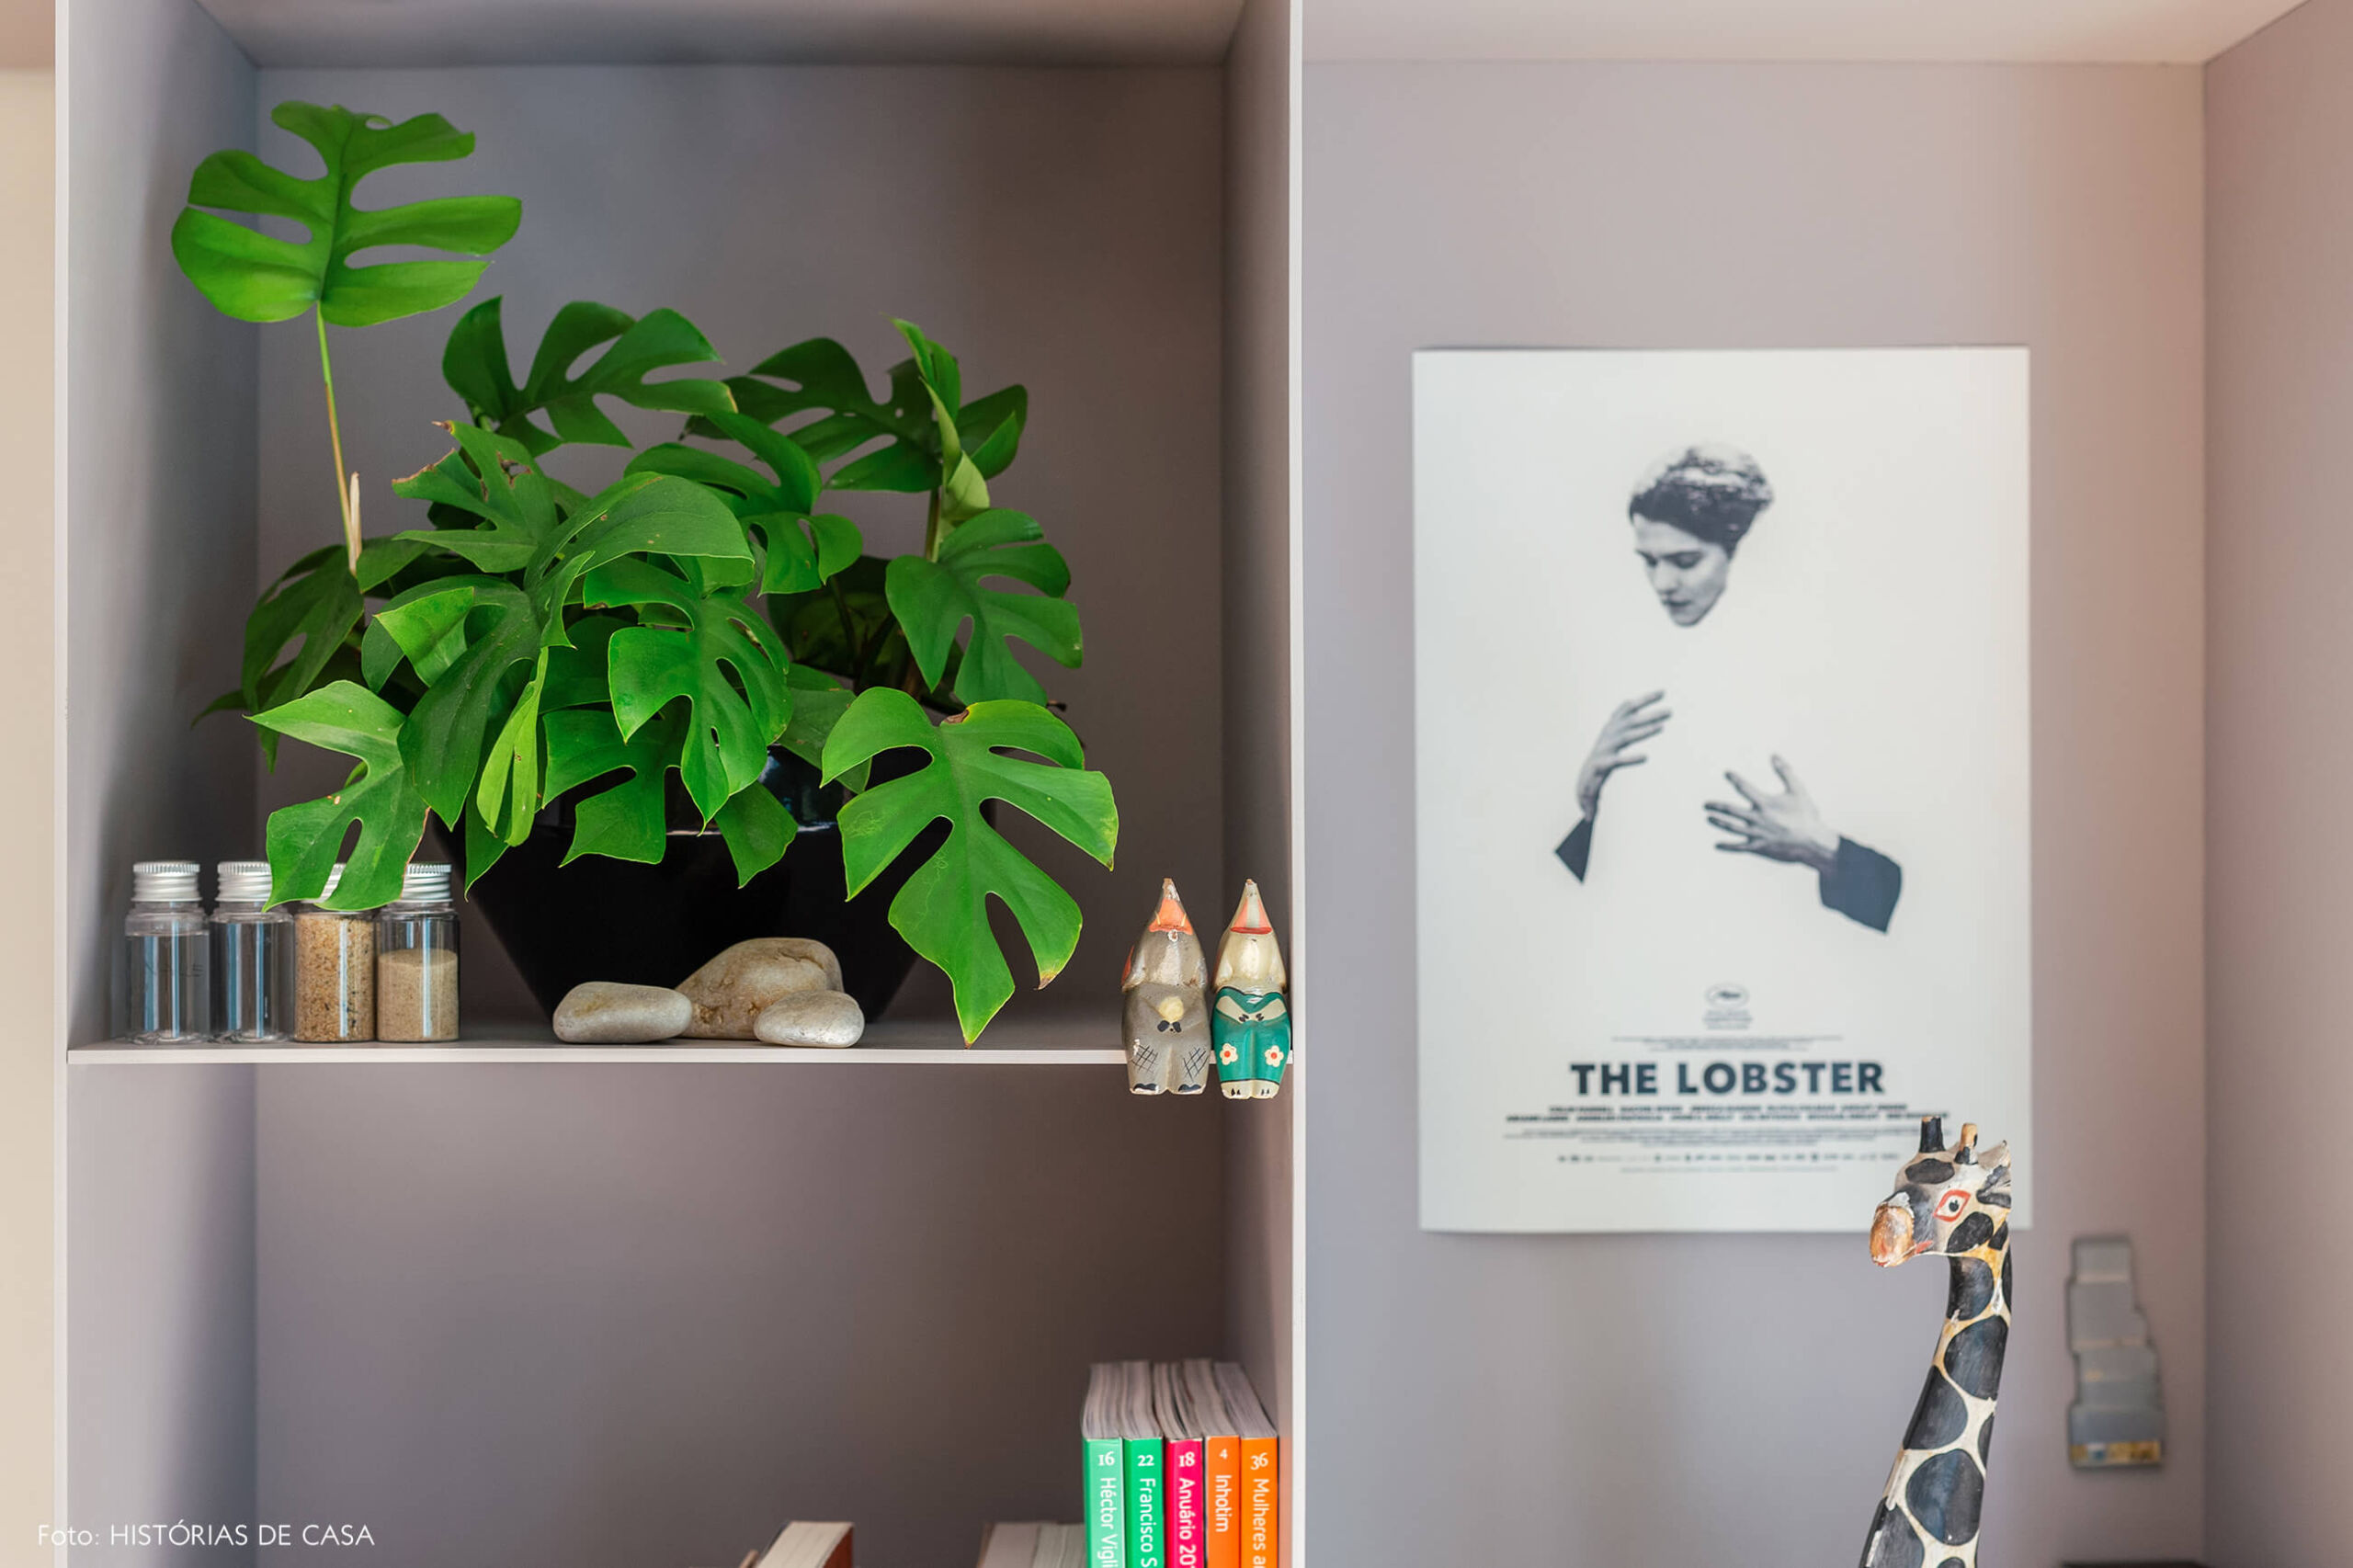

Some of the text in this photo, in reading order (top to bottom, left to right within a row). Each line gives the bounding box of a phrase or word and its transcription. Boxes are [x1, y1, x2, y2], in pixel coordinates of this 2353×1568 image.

[1570, 1061, 1884, 1096] THE LOBSTER
[1097, 1451, 1115, 1466] 16
[1137, 1454, 1154, 1467] 22
[1178, 1451, 1195, 1467] 18
[1219, 1449, 1228, 1460] 4
[1250, 1452, 1268, 1471] 36
[1099, 1477, 1118, 1530] Héctor
[1139, 1477, 1156, 1552] Francisco
[1215, 1474, 1233, 1532] Inhotim
[1253, 1478, 1269, 1551] Mulheres
[1178, 1477, 1197, 1568] Anuário 20
